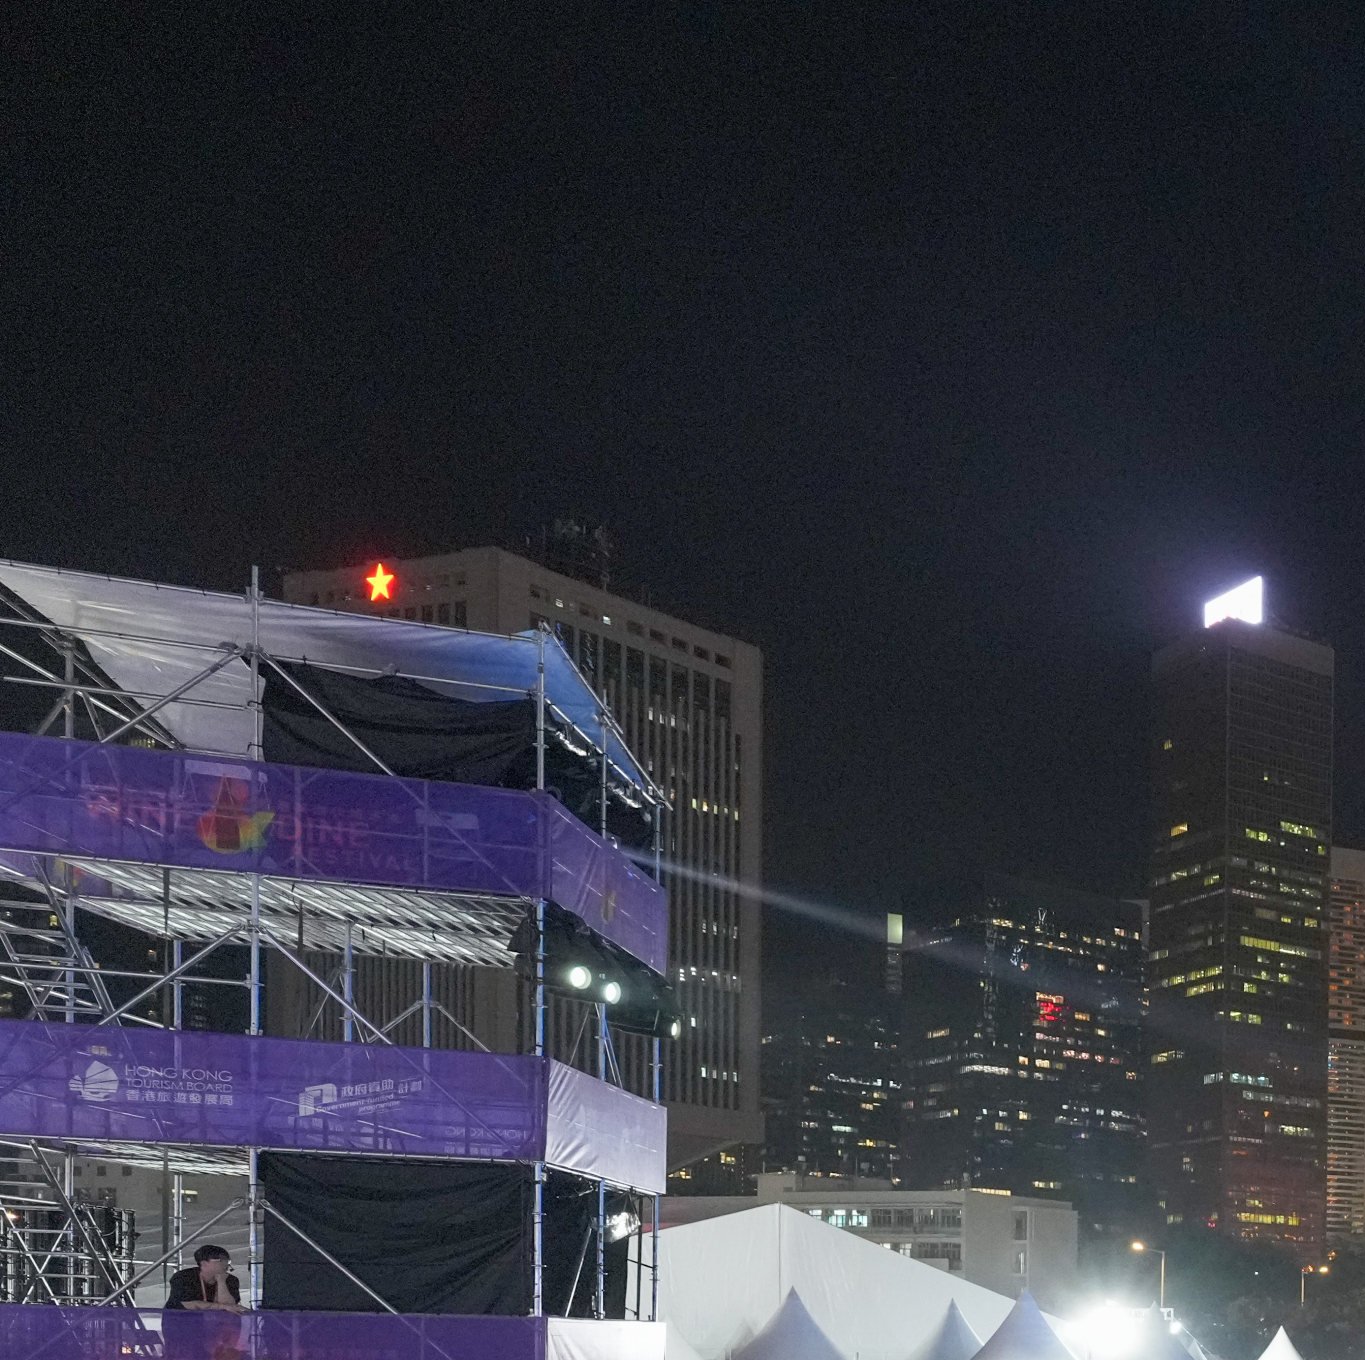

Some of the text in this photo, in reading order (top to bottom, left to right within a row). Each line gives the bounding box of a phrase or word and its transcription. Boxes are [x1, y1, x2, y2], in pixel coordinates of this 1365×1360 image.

[125, 1065, 232, 1081] HONG KONG
[126, 1078, 232, 1093] TOURISM BOARD
